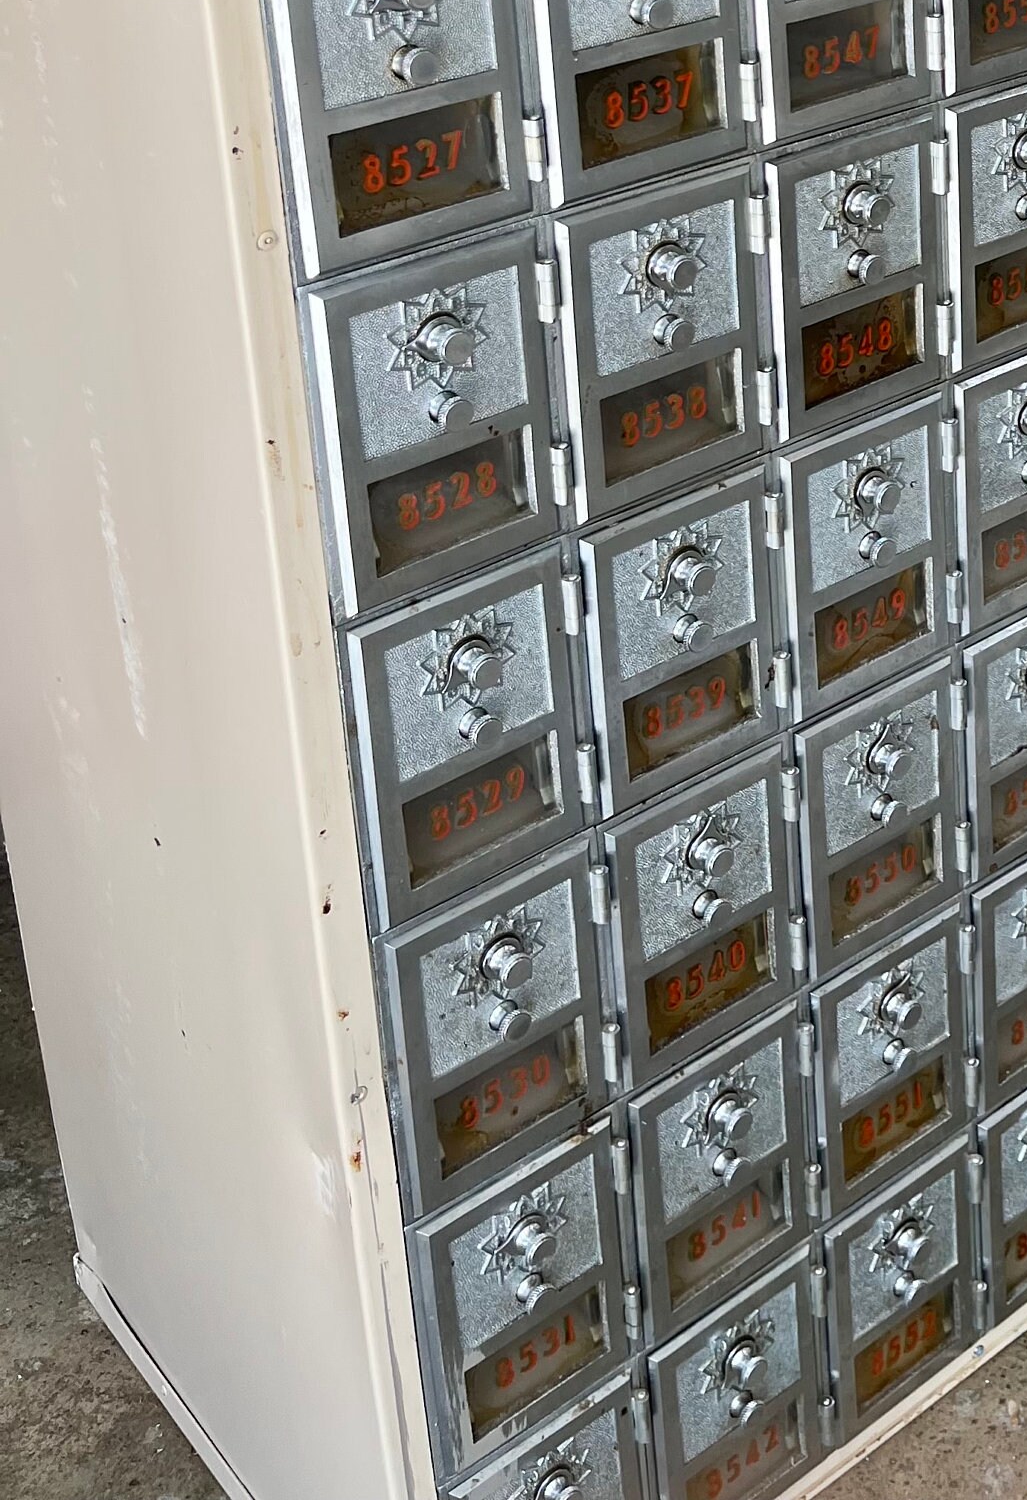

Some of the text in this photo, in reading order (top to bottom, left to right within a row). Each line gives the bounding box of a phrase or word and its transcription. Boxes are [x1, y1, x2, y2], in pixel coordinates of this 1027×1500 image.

[805, 25, 880, 79] 8547
[605, 71, 694, 129] 8537
[362, 131, 462, 194] 8527
[819, 318, 893, 377] 8548
[623, 388, 708, 447] 8538
[398, 462, 499, 531] 8528
[833, 588, 906, 650] 8549
[646, 678, 726, 738] 8539
[432, 768, 526, 841] 8529
[844, 846, 917, 905] 8550
[666, 940, 747, 1011] 8540
[460, 1057, 551, 1130] 8530
[858, 1082, 924, 1148] 8551
[692, 1191, 762, 1262] 8541
[495, 1316, 576, 1390] 8531
[870, 1310, 937, 1377] 8552
[704, 1426, 780, 1500] 8542
